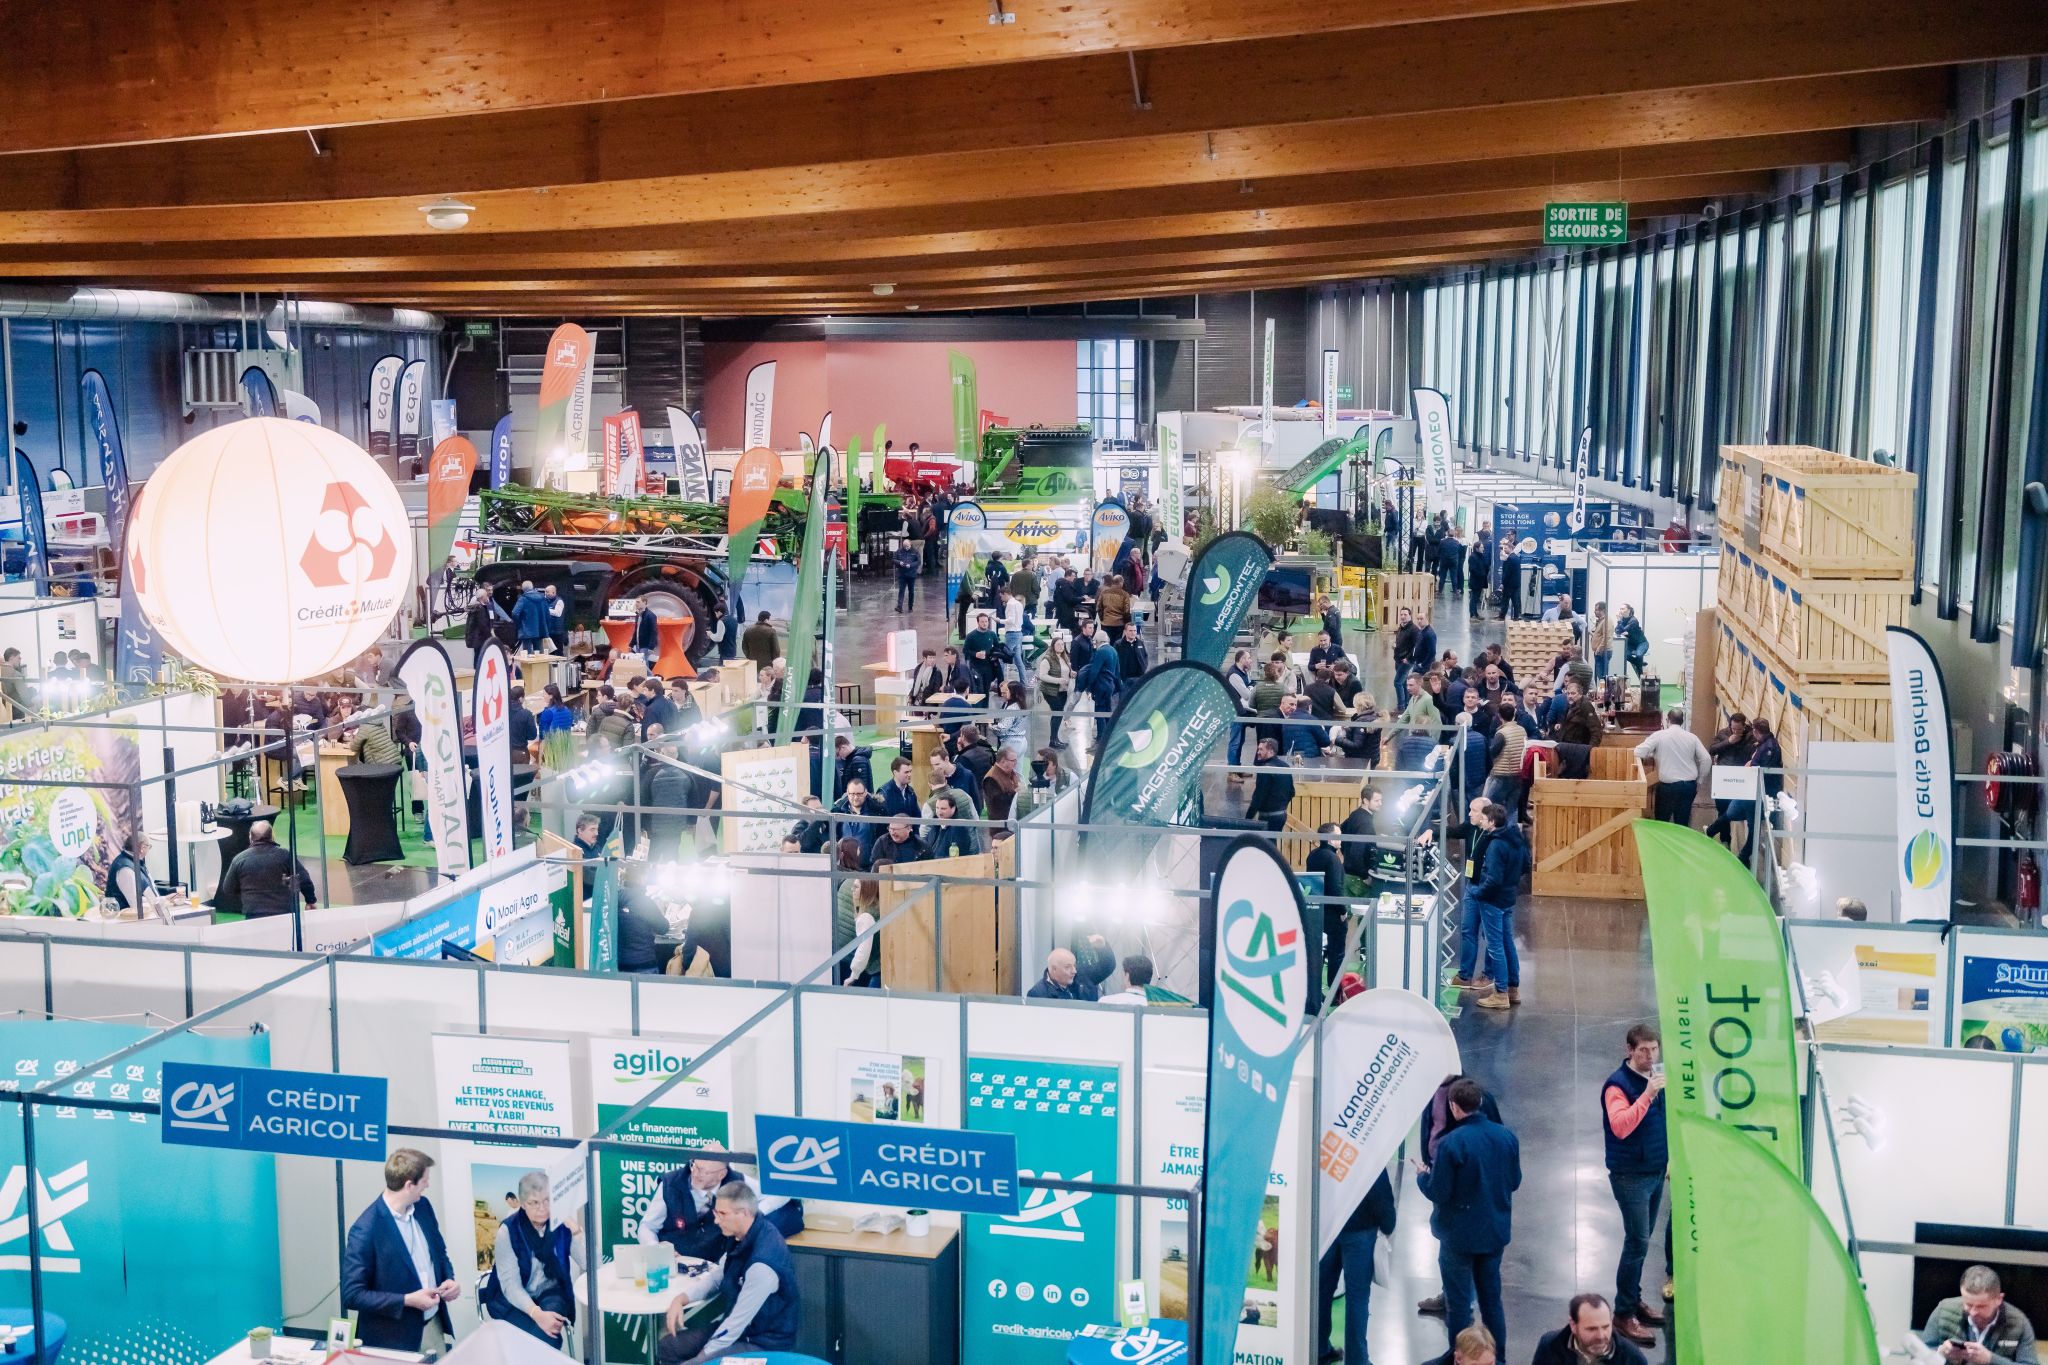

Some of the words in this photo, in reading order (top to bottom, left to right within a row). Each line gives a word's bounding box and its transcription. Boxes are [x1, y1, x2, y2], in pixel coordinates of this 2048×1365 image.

[1550, 208, 1598, 221] SORTIE
[1605, 208, 1622, 221] DE
[1549, 224, 1608, 238] SECOURS
[1575, 437, 1587, 524] BAOBAG
[1212, 560, 1257, 633] MAGROWTEC
[297, 604, 344, 620] Crédit
[1131, 704, 1212, 813] MAGROWTEC
[1151, 776, 1180, 813] MAKING
[1175, 750, 1198, 777] MORE
[1202, 717, 1221, 740] LESS
[61, 822, 91, 848] unpt
[518, 892, 539, 910] Agro
[483, 1058, 523, 1067] ASSURANCES
[613, 1049, 692, 1076] agilor
[1333, 1033, 1398, 1129] Vandoorne
[1347, 1040, 1411, 1139] installatiebedrijf
[267, 1087, 361, 1113] CRÉDIT
[462, 1086, 472, 1095] LE
[475, 1086, 504, 1096] TEMPS
[507, 1088, 546, 1100] CHANGE,
[455, 1097, 490, 1107] METTEZ
[492, 1098, 510, 1108] VOS
[512, 1100, 554, 1112] REVENUS
[497, 1110, 525, 1121] L'ABRI
[249, 1115, 380, 1142] AGRICOLE
[450, 1121, 474, 1131] AVEC
[475, 1123, 495, 1133] NOS
[495, 1124, 559, 1137] ASSURANCES
[621, 1133, 644, 1142] votre
[646, 1134, 683, 1145] matériel
[628, 1121, 639, 1132] Le
[642, 1122, 698, 1135] financement
[878, 1142, 986, 1168] CRÉDIT
[1169, 1143, 1200, 1159] ÊTRE
[620, 1160, 645, 1172] UNE
[1160, 1162, 1203, 1177] JAMAIS
[1269, 1171, 1288, 1188] ÉS,
[859, 1168, 1011, 1197] AGRICOLE
